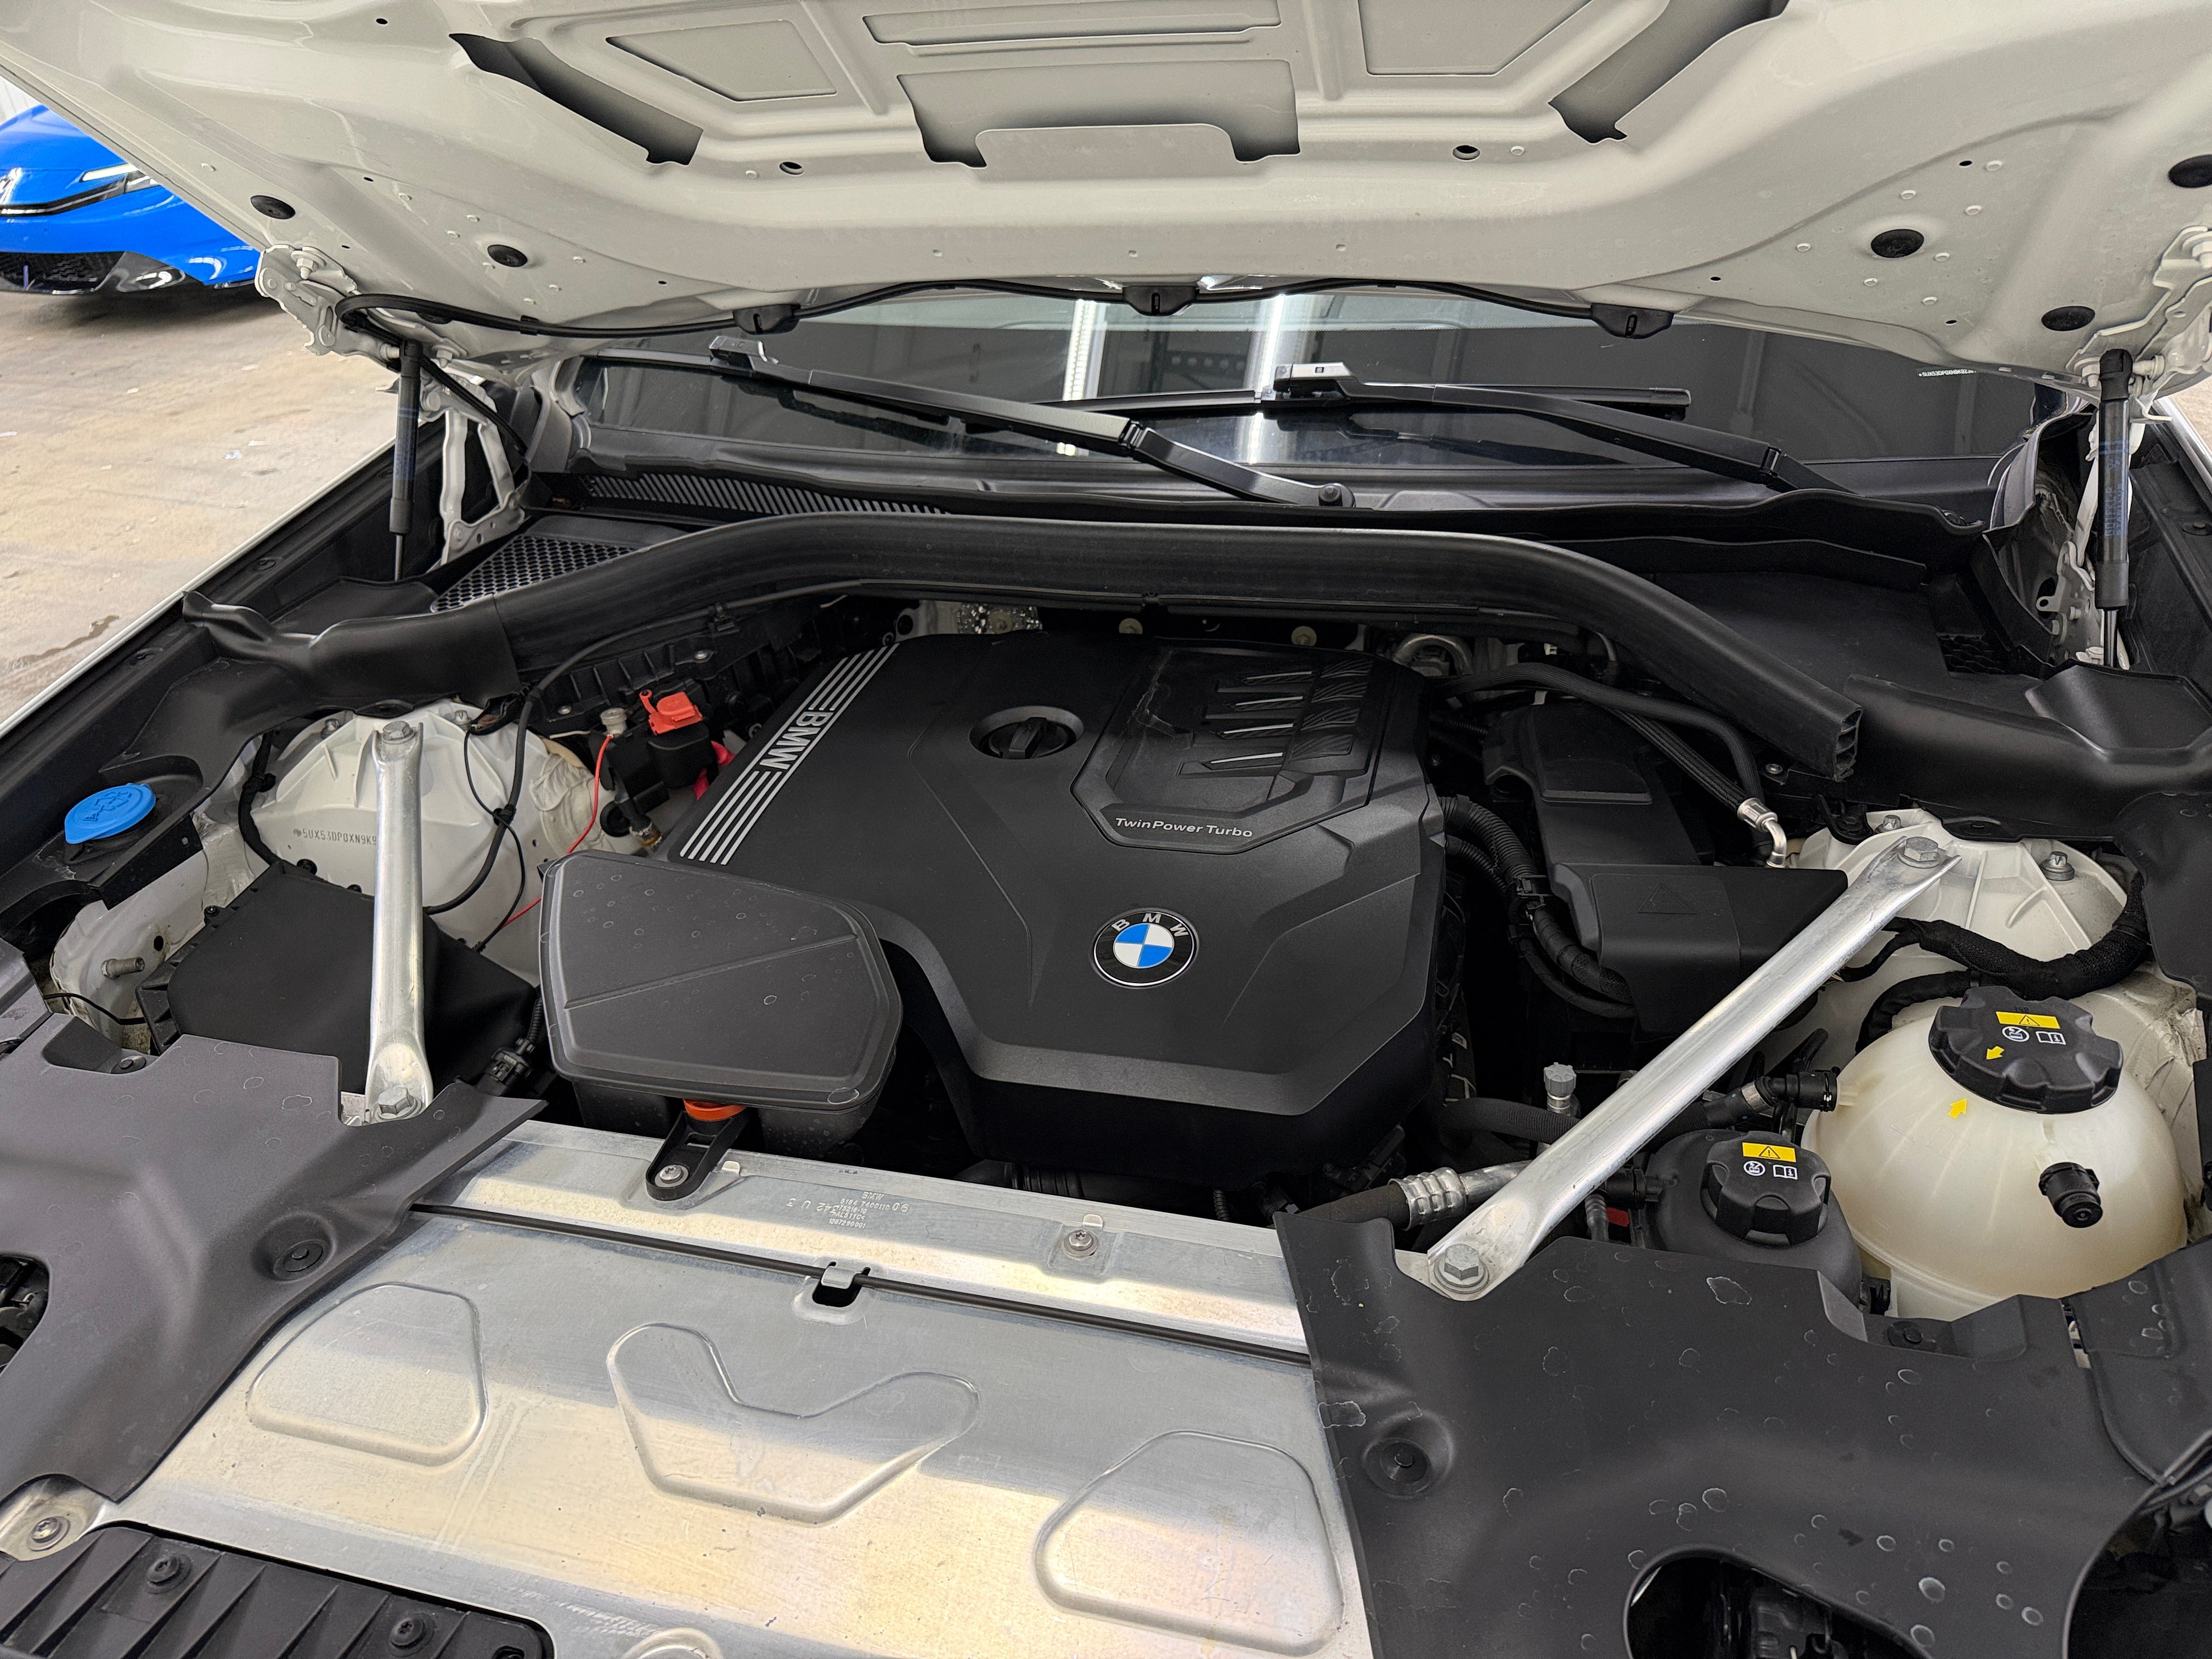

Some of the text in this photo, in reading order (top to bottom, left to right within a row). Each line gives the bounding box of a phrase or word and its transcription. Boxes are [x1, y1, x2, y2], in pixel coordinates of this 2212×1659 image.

[759, 711, 833, 770] BMW
[1115, 817, 1253, 838] TwinPower Turbo
[1111, 913, 1188, 938] BMW
[861, 1191, 885, 1201] BMW
